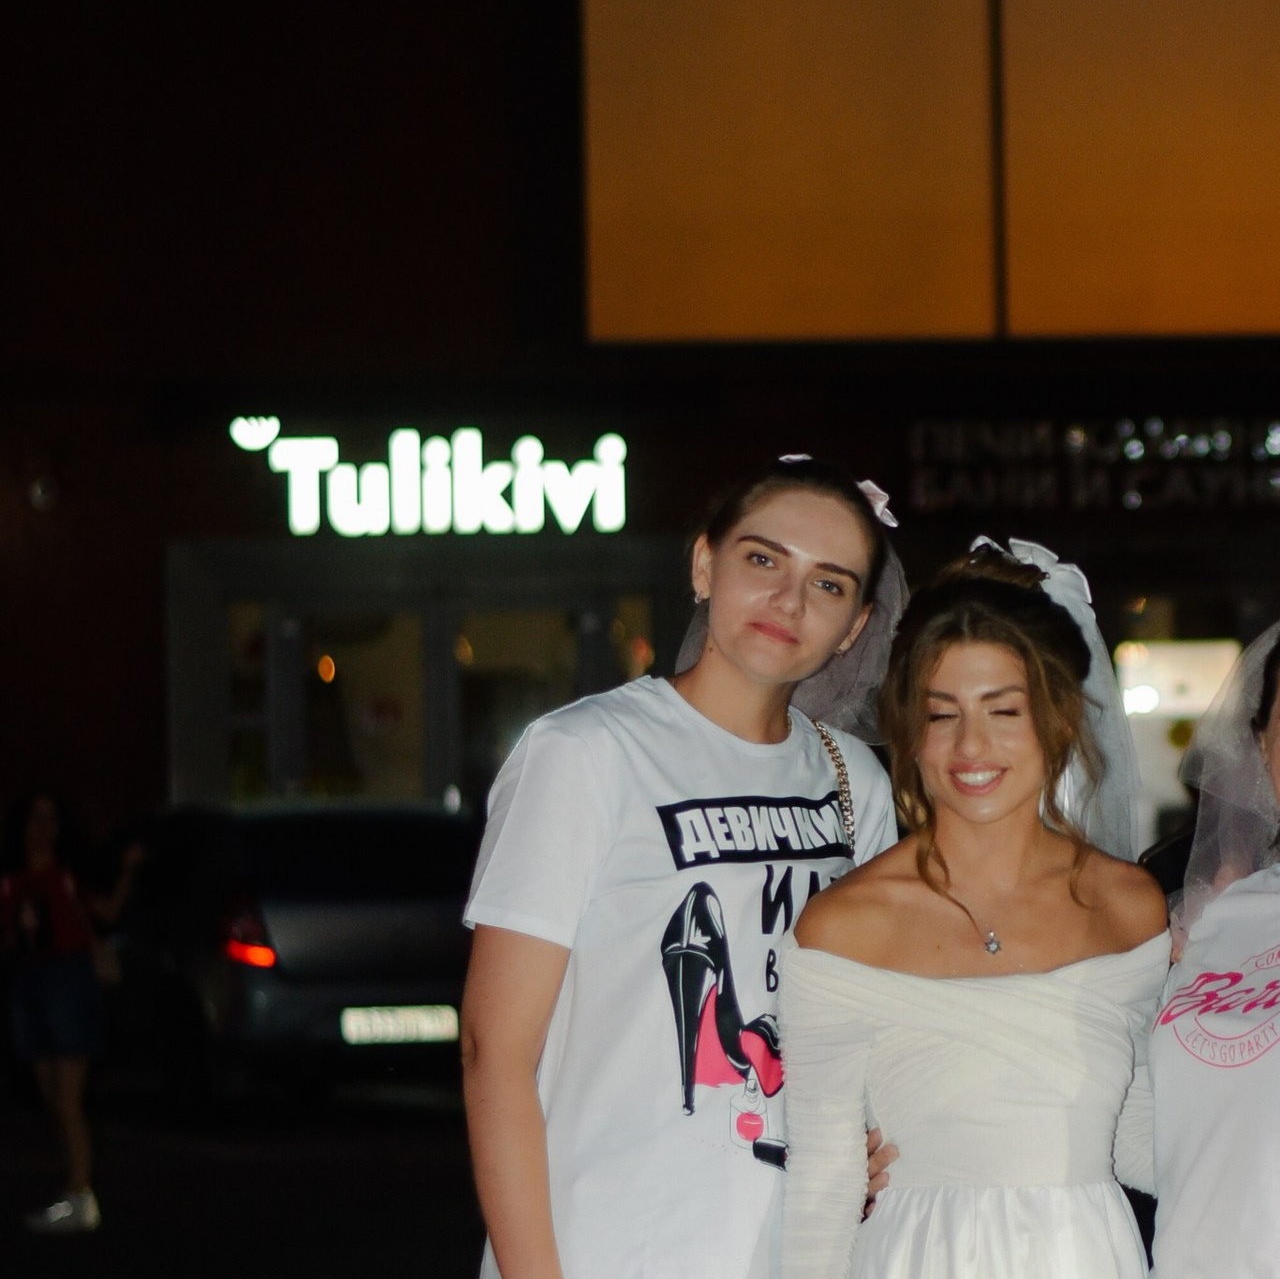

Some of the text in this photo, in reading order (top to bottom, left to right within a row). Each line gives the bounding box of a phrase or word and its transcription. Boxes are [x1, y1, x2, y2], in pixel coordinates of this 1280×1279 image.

[268, 427, 628, 537] Tulikivi
[1185, 1022, 1278, 1063] LET'S GO PARTY
